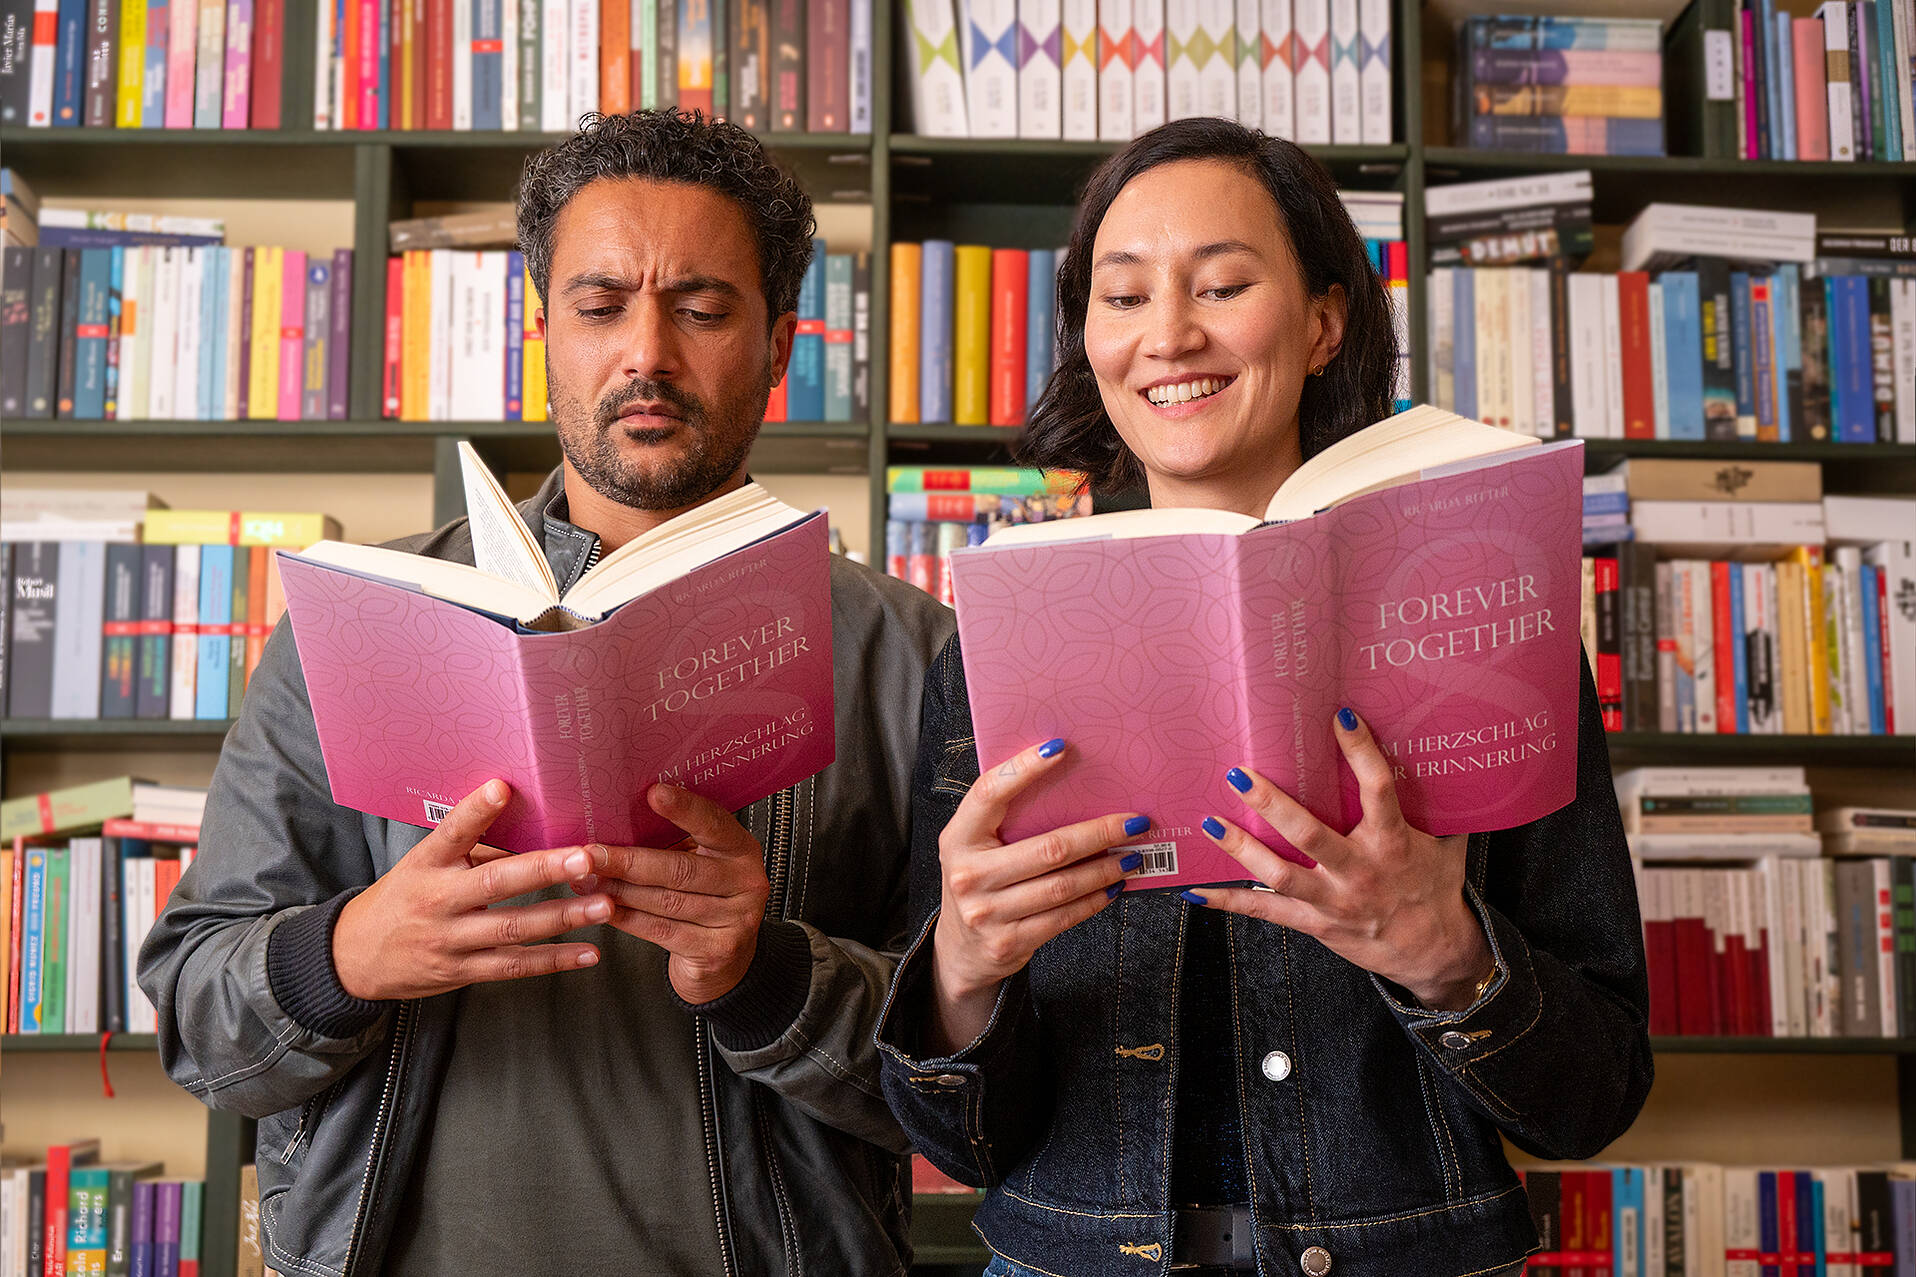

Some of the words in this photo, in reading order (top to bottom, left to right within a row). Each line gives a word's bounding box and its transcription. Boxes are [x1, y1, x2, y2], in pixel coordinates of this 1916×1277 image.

[1470, 233, 1552, 260] DEMUT
[1872, 313, 1893, 401] DEMUT
[1403, 495, 1462, 517] RICARDA
[1464, 486, 1509, 506] RITTER
[16, 583, 54, 600] Musil
[674, 577, 725, 604] RICARDA
[726, 558, 768, 580] RITTER
[1378, 574, 1539, 630] FOREVER
[657, 616, 795, 690] FOREVER
[1271, 610, 1290, 679] FOREVER
[1291, 596, 1310, 682] TOGETHER
[1360, 608, 1555, 671] TOGETHER
[643, 636, 811, 722] TOGETHER
[555, 693, 574, 740] FOREVER
[574, 684, 594, 744] TOGETHER
[1381, 741, 1399, 757] M
[1407, 710, 1548, 756] HERZSCHLAG
[657, 765, 680, 784] IM
[685, 706, 806, 772] HERZSCHLAG
[693, 720, 815, 786] ERINNERUNG
[1416, 732, 1557, 779] ERINNERUNG
[406, 786, 456, 805] RICARDA
[1149, 826, 1193, 839] RITTER
[74, 1191, 89, 1244] Richard
